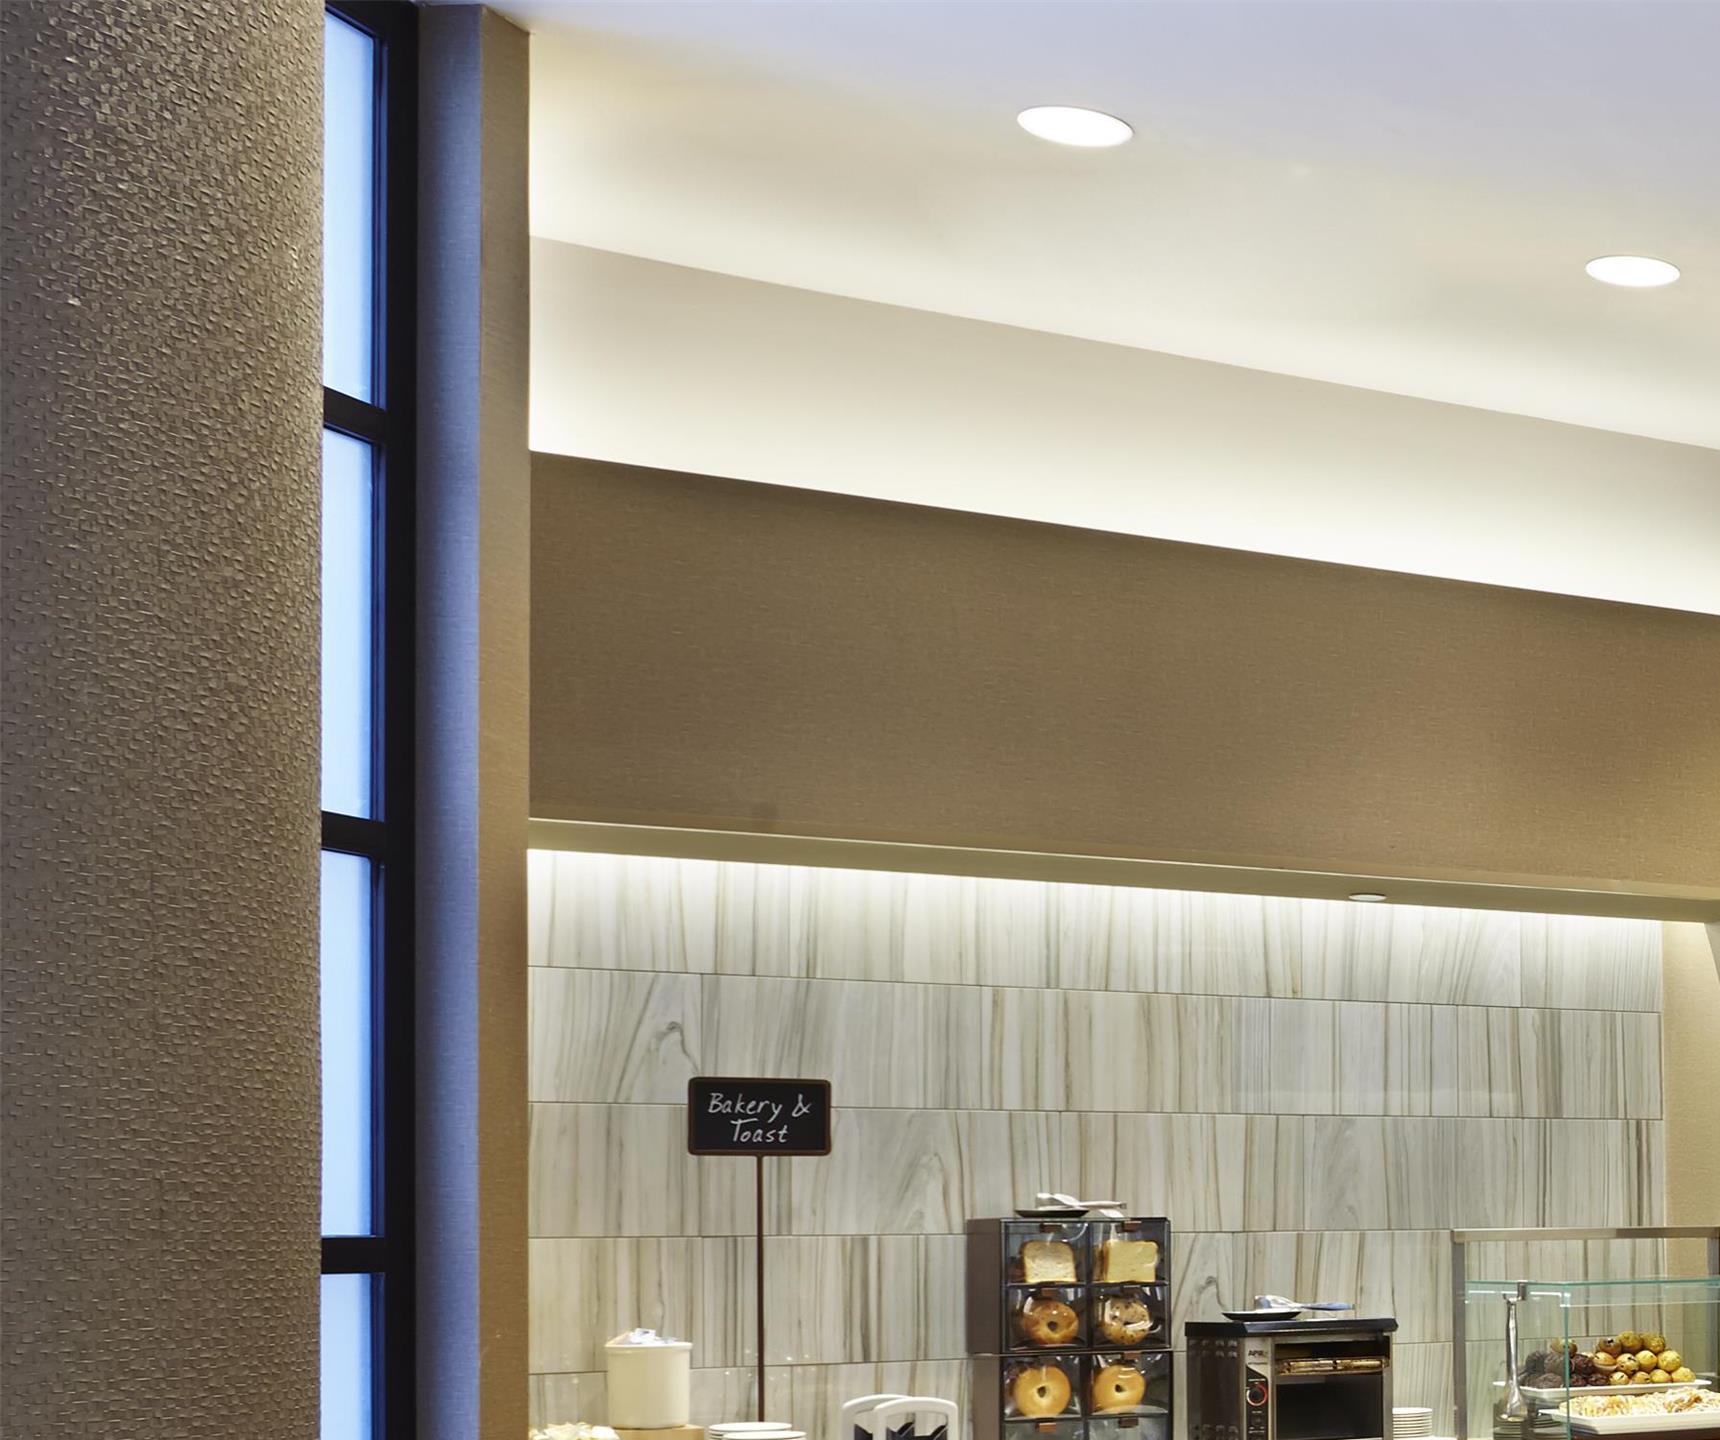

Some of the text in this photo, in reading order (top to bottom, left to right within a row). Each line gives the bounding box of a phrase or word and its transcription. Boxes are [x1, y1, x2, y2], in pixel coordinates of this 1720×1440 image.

[708, 1093, 811, 1123] Bakery &
[731, 1118, 787, 1142] Toast
